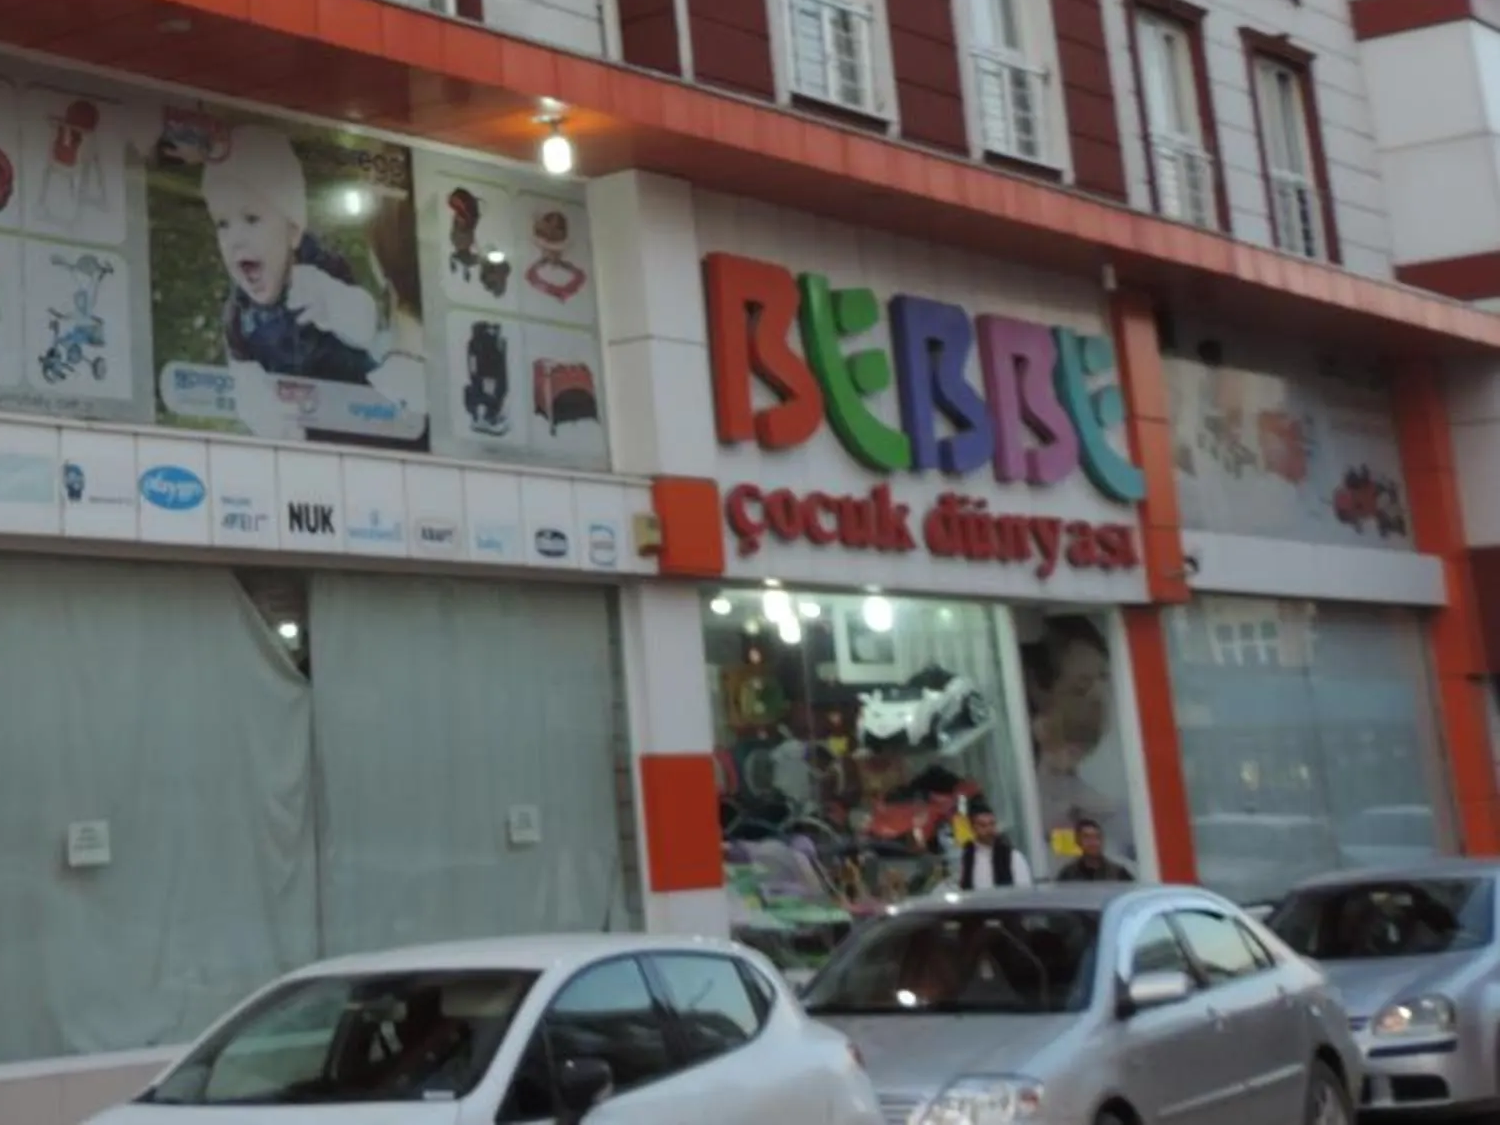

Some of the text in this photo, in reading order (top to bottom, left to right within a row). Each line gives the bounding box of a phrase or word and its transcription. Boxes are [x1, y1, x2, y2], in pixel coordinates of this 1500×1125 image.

[288, 502, 335, 534] NUK
[727, 482, 1140, 578] çocuk dünyası
